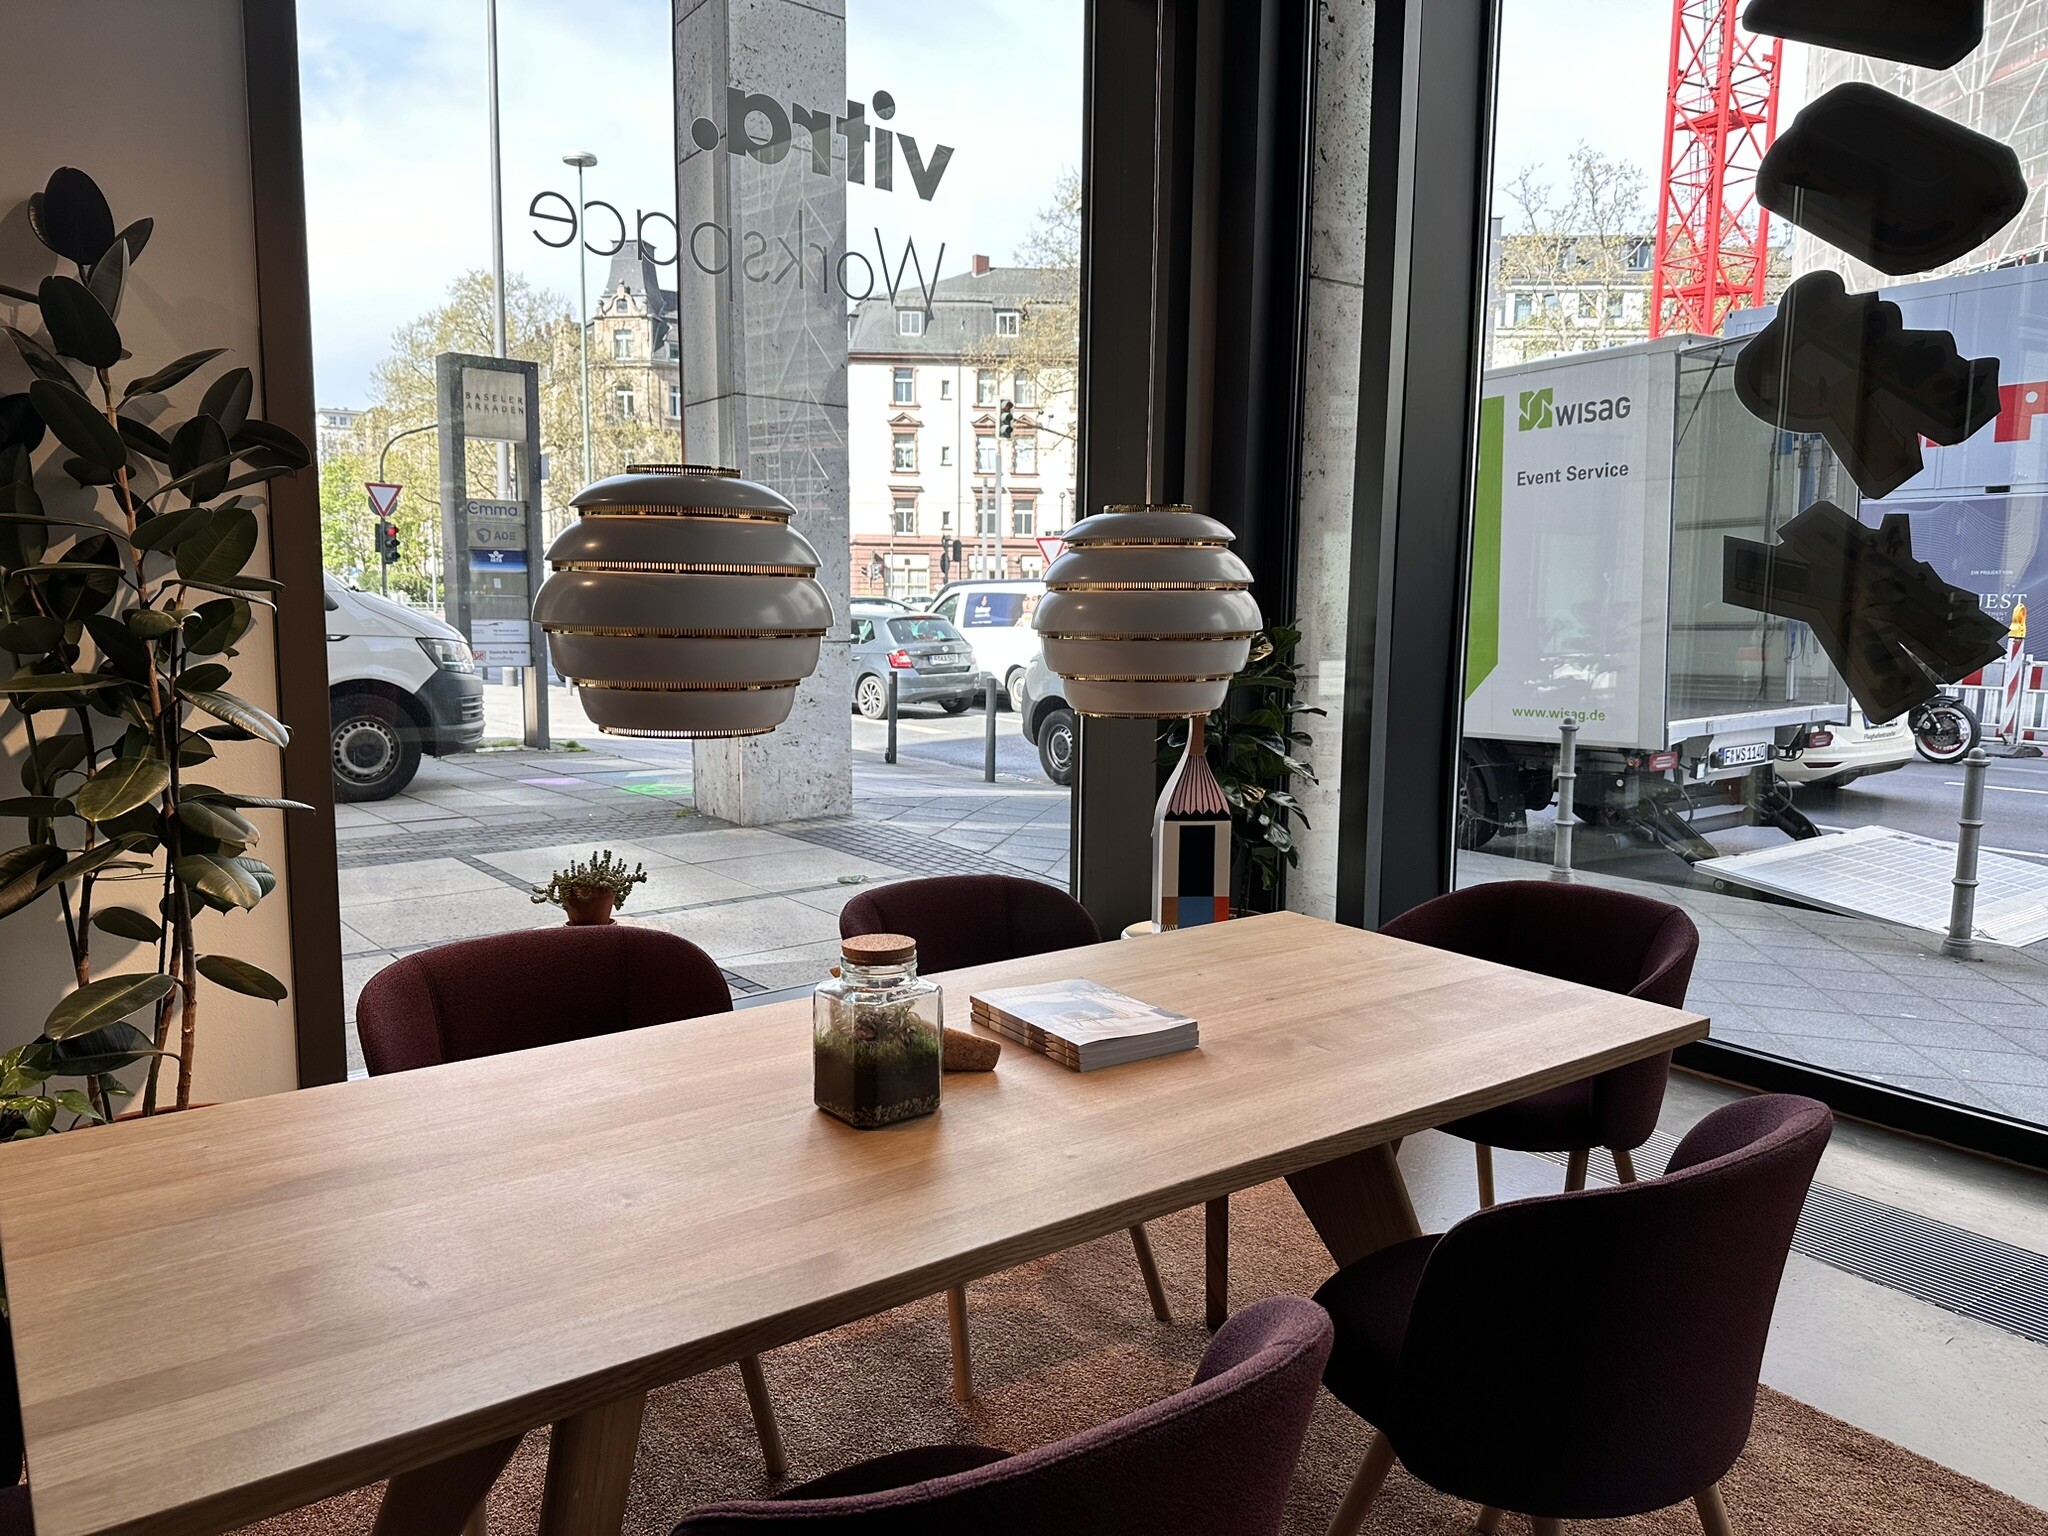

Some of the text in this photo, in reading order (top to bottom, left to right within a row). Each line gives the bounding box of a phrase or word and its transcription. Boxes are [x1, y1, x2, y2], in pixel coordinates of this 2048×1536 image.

[465, 392, 523, 404] BASELER
[466, 402, 524, 414] ARKADEN
[1517, 462, 1629, 486] Event Service
[1512, 707, 1605, 722] www.wisag.de
